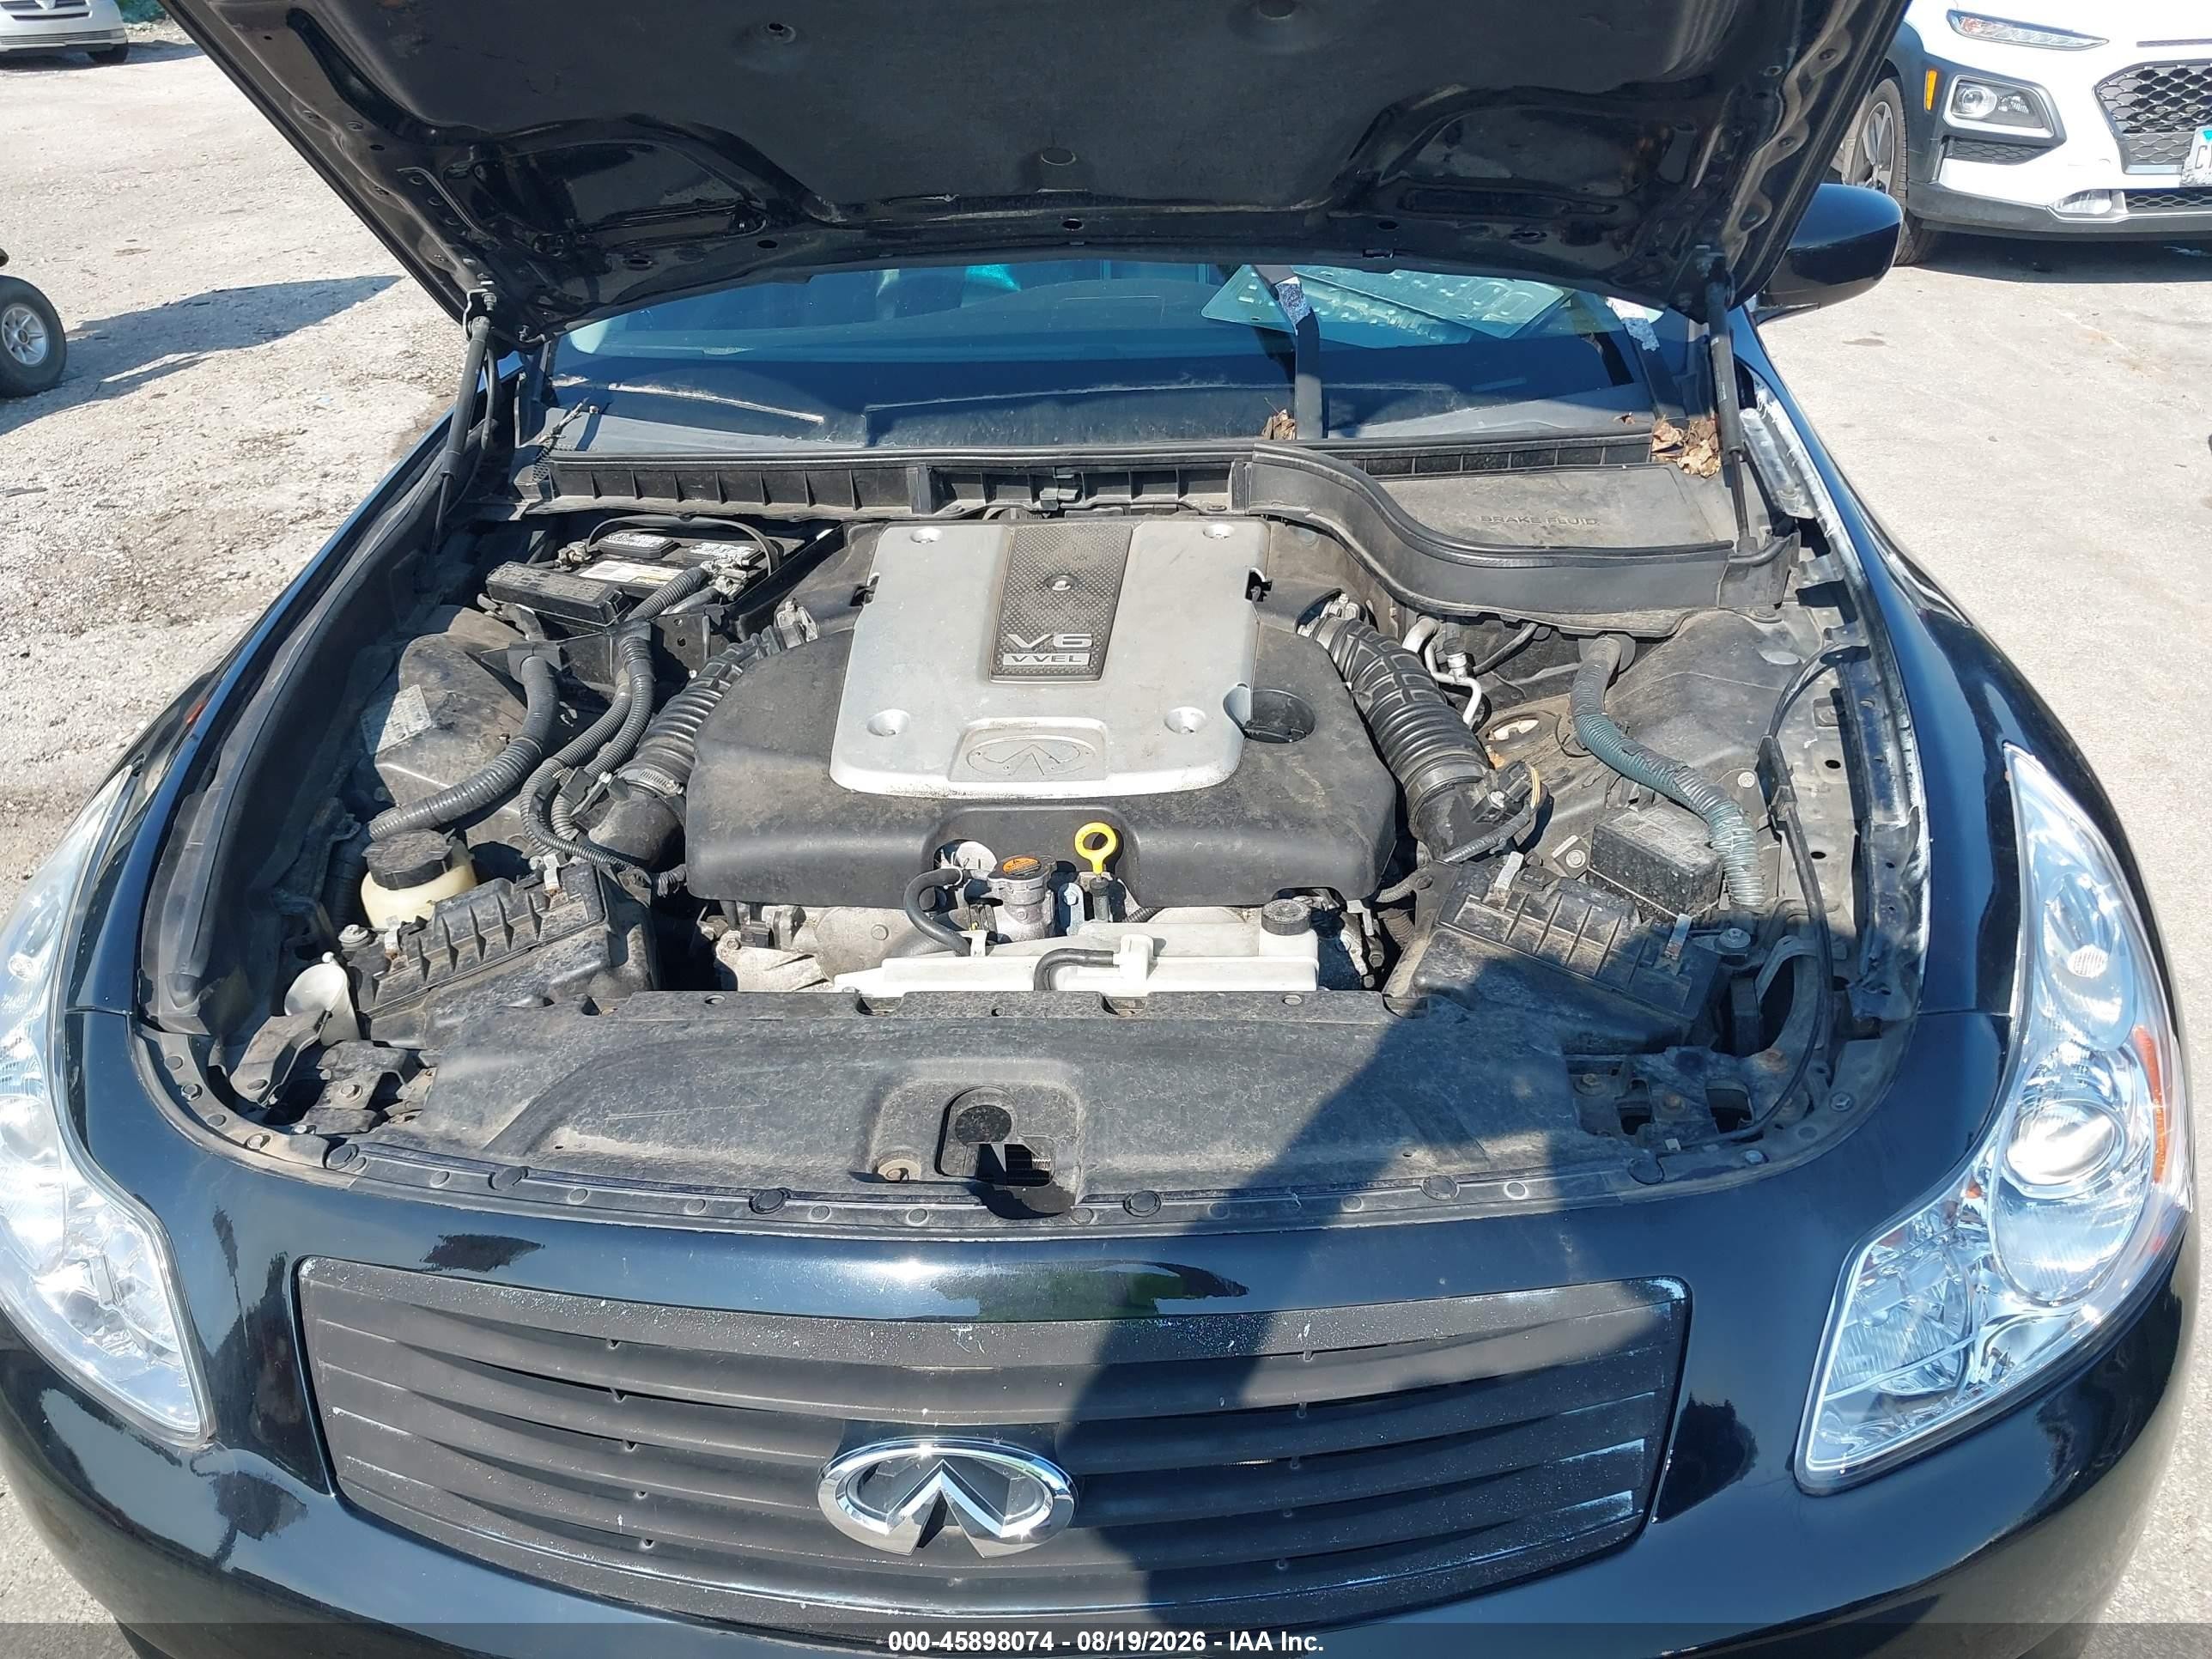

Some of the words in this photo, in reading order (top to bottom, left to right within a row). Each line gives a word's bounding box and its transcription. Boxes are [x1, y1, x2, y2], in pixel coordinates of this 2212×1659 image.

[1478, 515, 1542, 525] BRAKE
[1546, 517, 1599, 526] FLUID
[1006, 633, 1093, 649] V6
[1011, 654, 1083, 663] VVEL
